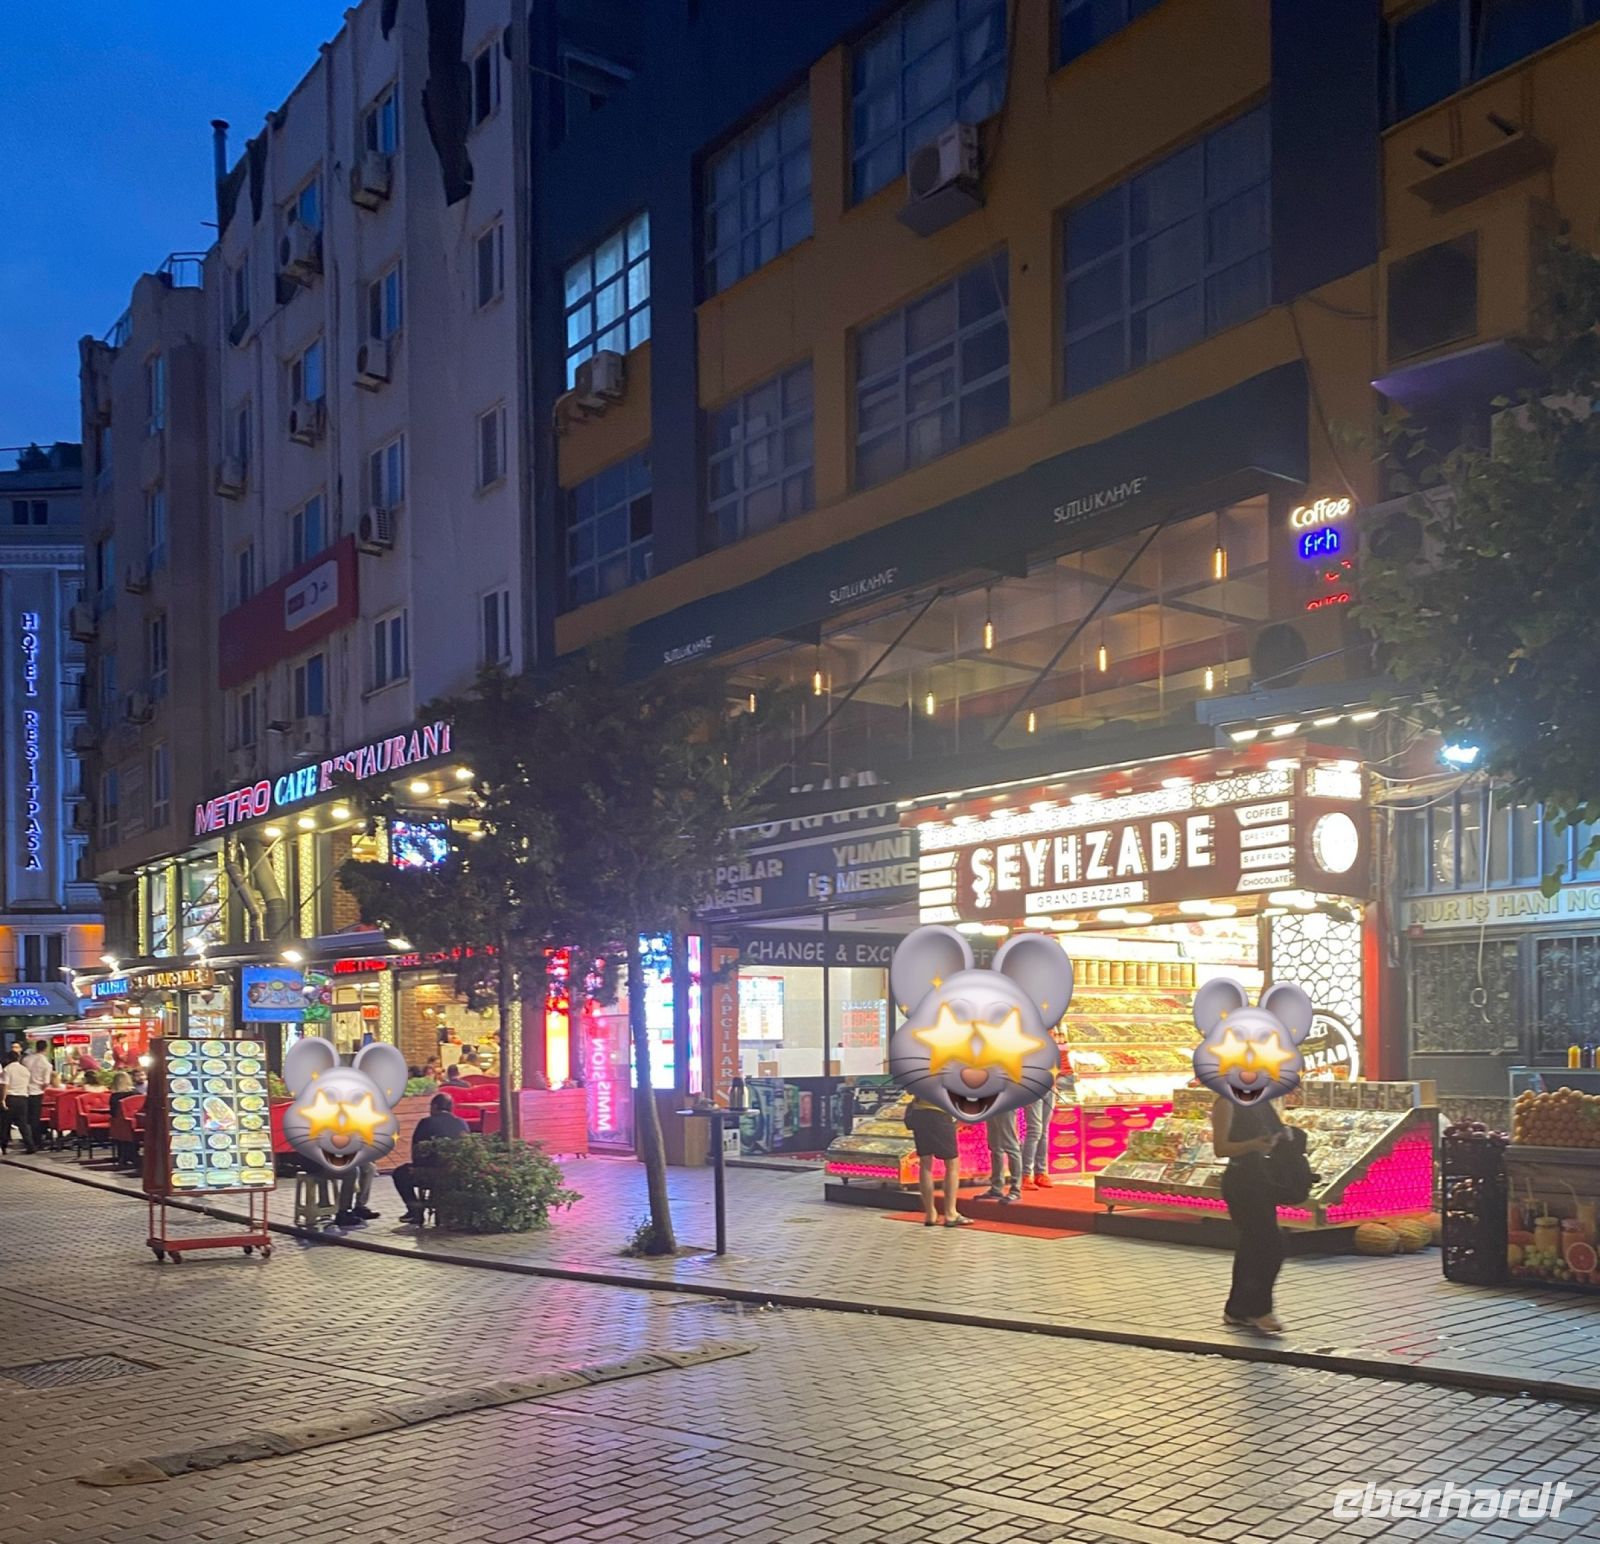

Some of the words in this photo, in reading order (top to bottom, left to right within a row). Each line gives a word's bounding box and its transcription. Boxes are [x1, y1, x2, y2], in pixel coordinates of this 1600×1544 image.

[1291, 498, 1351, 528] Coffee
[21, 611, 39, 697] HOTEL
[195, 779, 271, 836] METRO
[274, 765, 318, 806] CAFE
[1245, 806, 1284, 820] COFFEE
[836, 862, 920, 895] MERKE
[1242, 874, 1290, 887] CHOCOLATE
[1037, 892, 1078, 908] GRAND
[1081, 886, 1132, 903] BAZZAR
[1410, 899, 1461, 924] NUR
[747, 940, 825, 962] CHANGE
[836, 944, 848, 962] &
